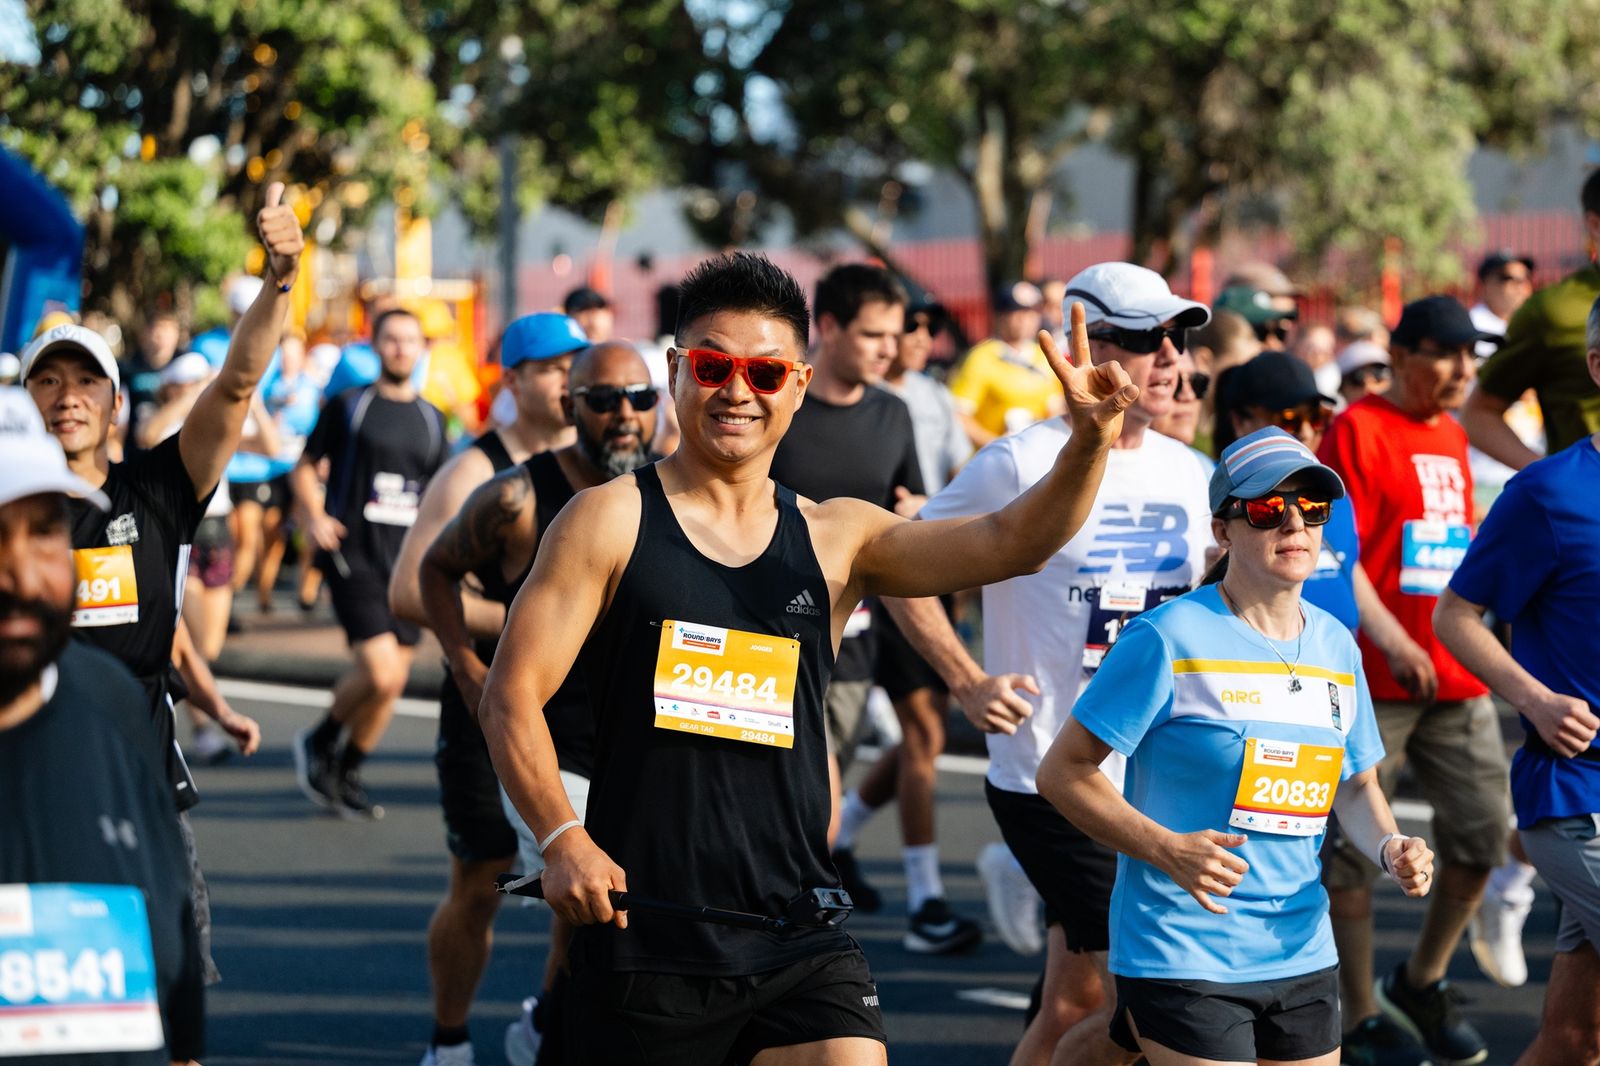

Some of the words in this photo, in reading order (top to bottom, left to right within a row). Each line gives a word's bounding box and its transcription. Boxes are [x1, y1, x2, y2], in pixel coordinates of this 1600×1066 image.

[1068, 585, 1101, 603] ne
[785, 604, 821, 616] adidas
[683, 632, 705, 641] ROUND
[706, 636, 721, 644] BAYS
[671, 662, 778, 705] 29484
[1221, 689, 1262, 705] ARG
[679, 722, 698, 731] GEAR
[700, 725, 714, 733] TAG
[740, 730, 776, 744] 29484
[1252, 776, 1331, 809] 20833
[0, 949, 126, 1003] 8541
